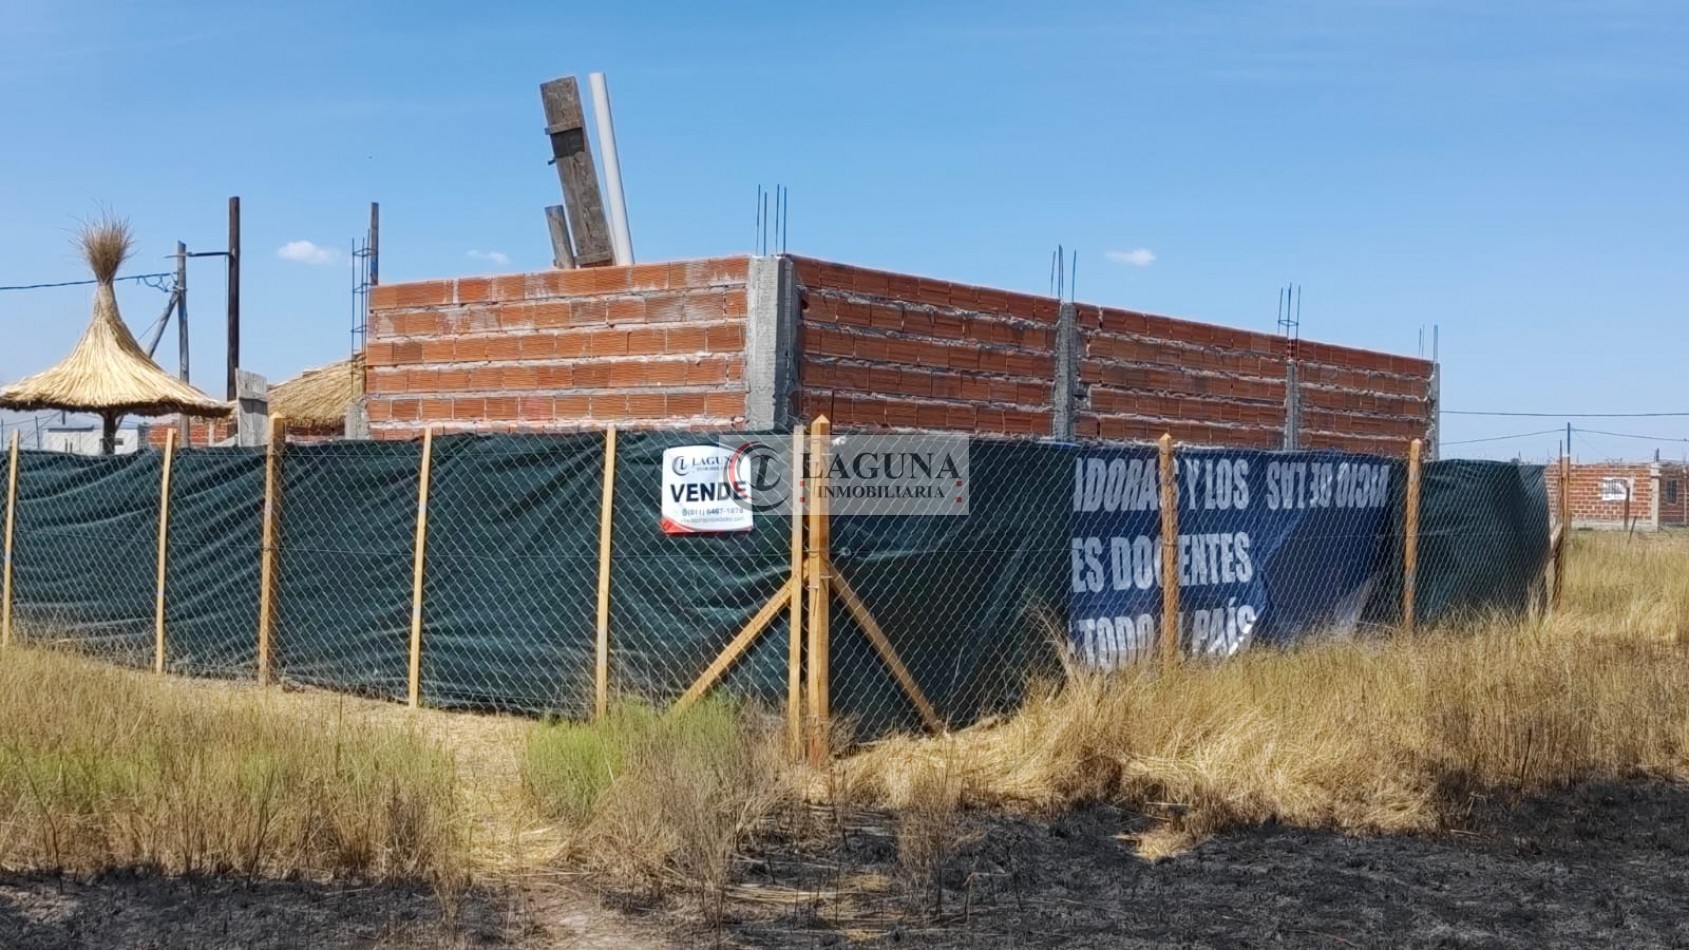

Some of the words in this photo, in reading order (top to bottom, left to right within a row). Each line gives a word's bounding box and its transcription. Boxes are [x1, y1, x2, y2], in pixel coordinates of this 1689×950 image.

[670, 482, 748, 503] VENDE
[1205, 457, 1249, 510] LOS
[1265, 461, 1306, 510] LAS
[1071, 535, 1105, 593] ES
[1079, 613, 1155, 670] TODO
